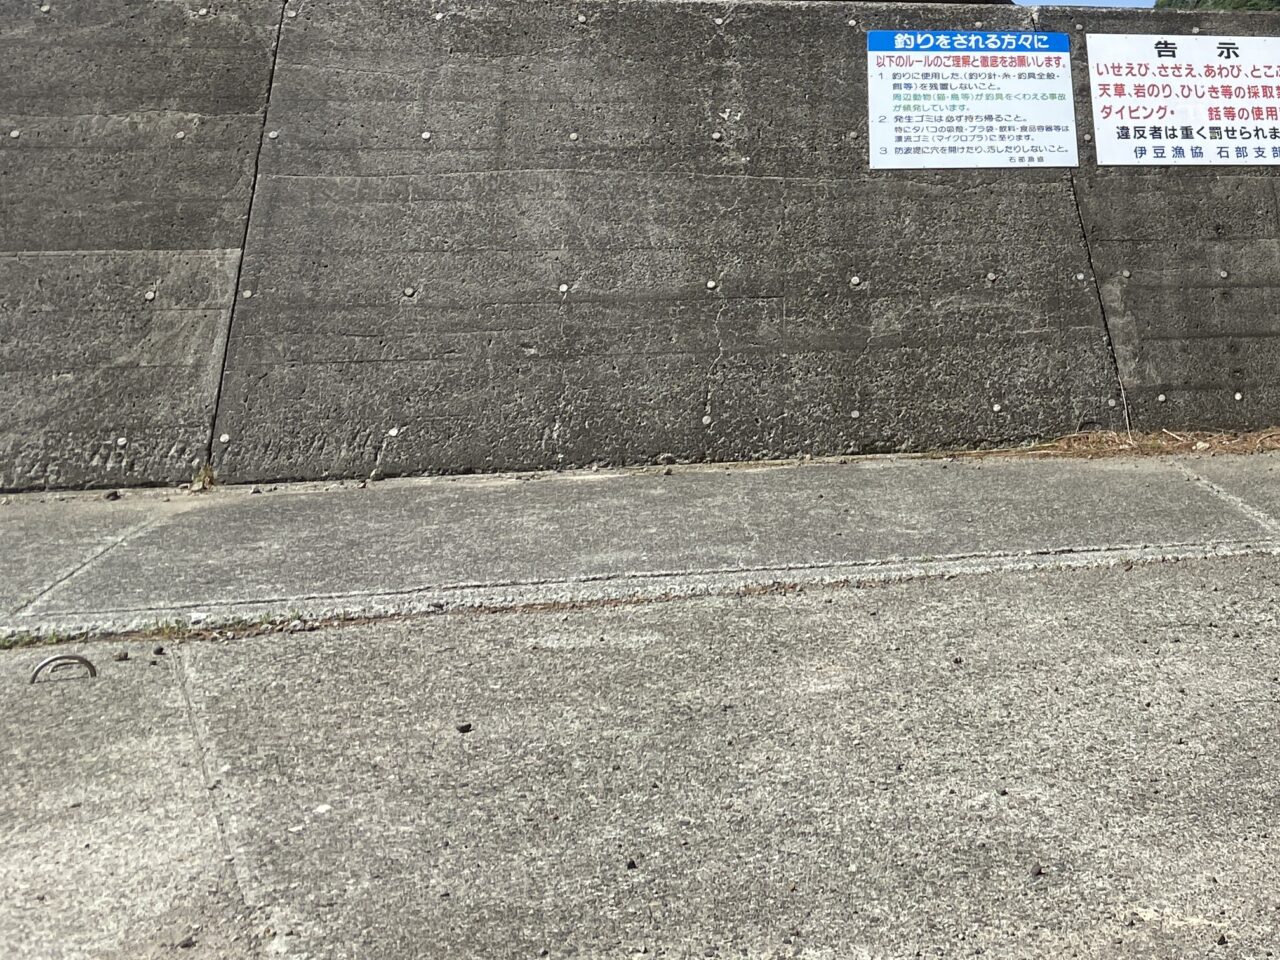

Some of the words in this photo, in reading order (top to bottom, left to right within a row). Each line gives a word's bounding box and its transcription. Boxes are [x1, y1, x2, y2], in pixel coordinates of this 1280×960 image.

[894, 33, 1049, 49] 釣りをされる方々に
[876, 55, 1066, 69] 以下のルールのご理解と徹底をお願いします。
[878, 115, 887, 123] 2
[879, 147, 888, 155] 3
[1134, 145, 1204, 159] 伊豆漁協
